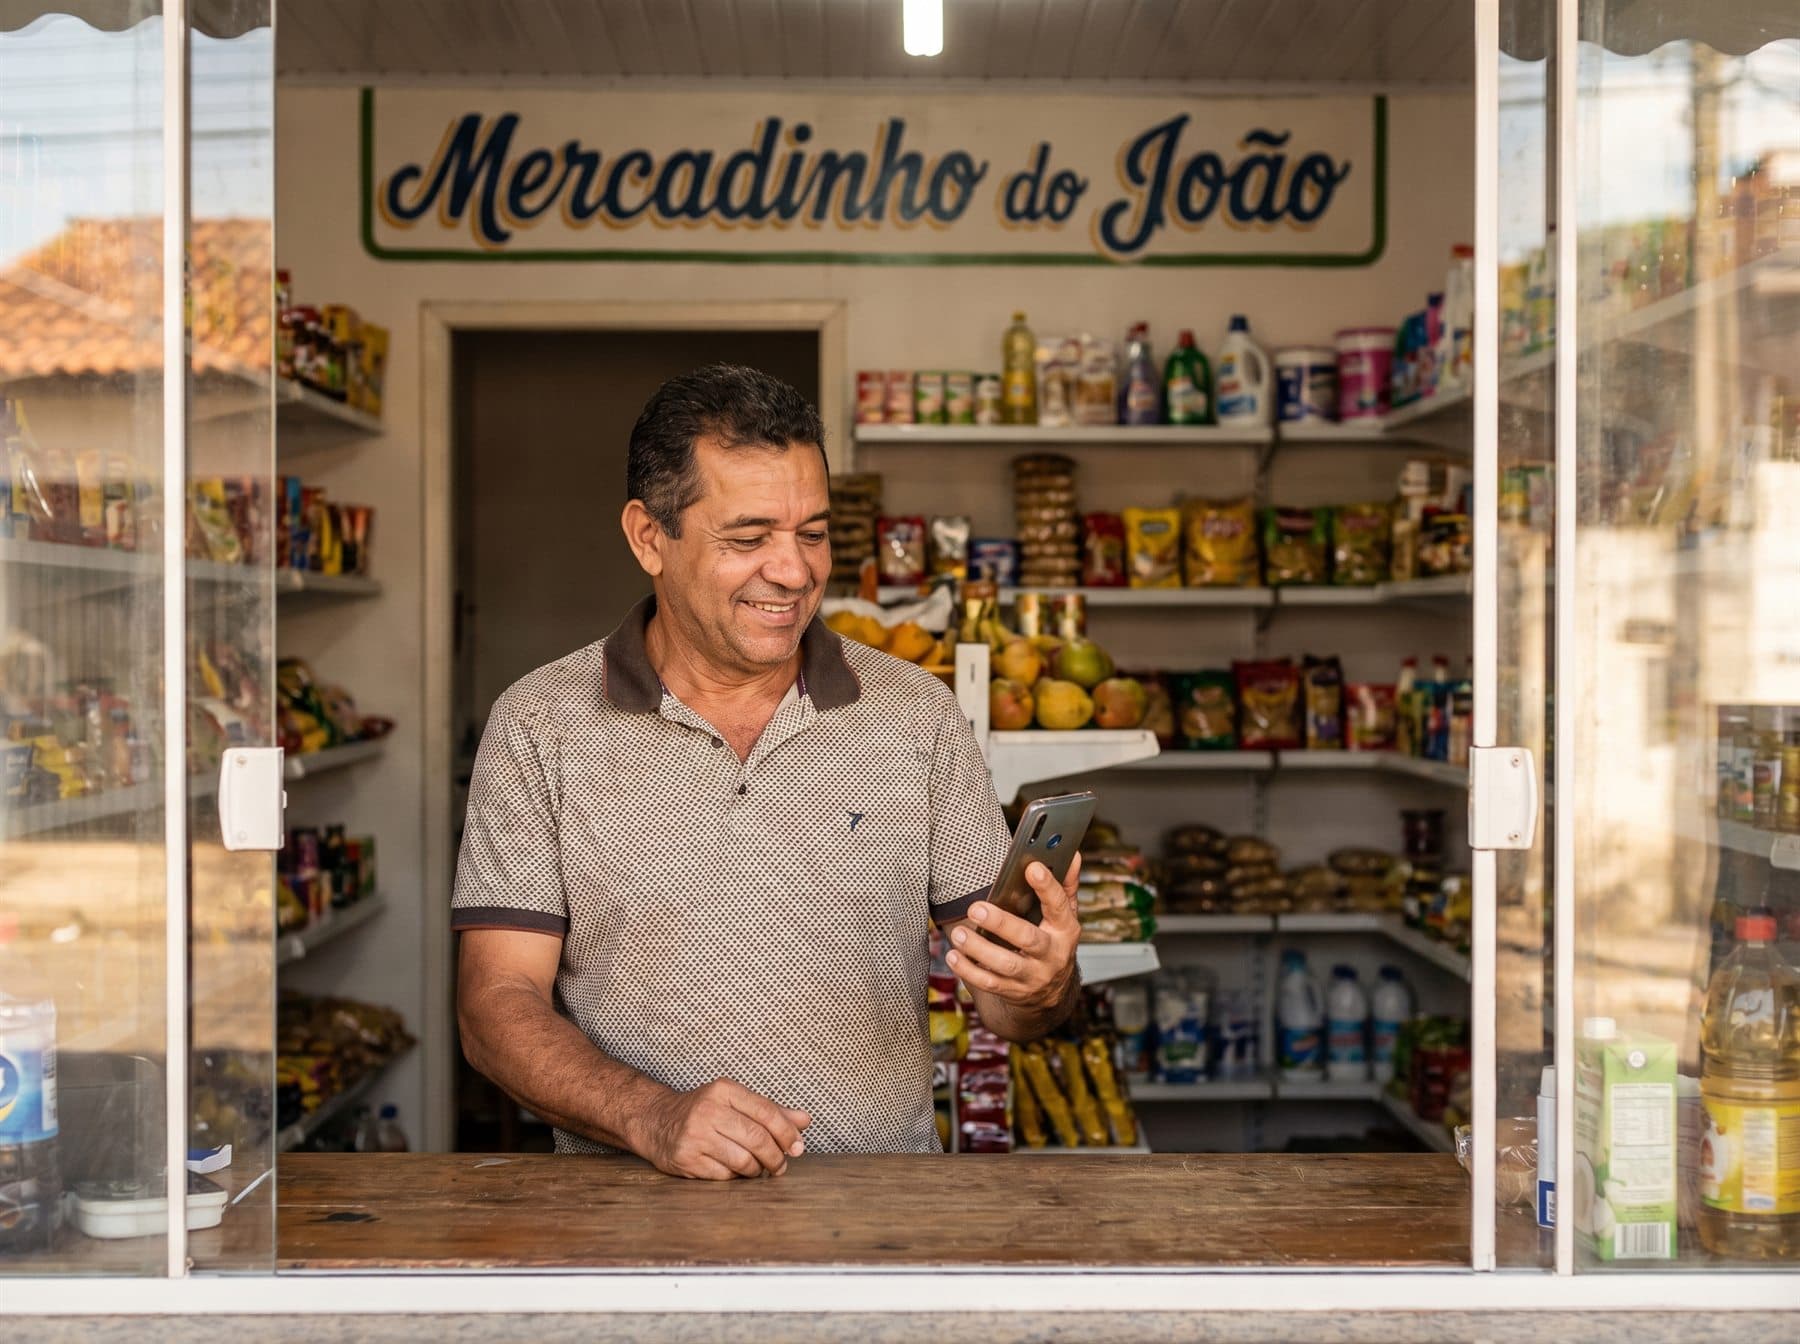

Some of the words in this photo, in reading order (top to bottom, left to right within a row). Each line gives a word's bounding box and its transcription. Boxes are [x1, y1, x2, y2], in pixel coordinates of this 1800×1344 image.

[380, 112, 989, 248] Mercadinho
[998, 141, 1089, 229] do
[1091, 113, 1351, 259] João
